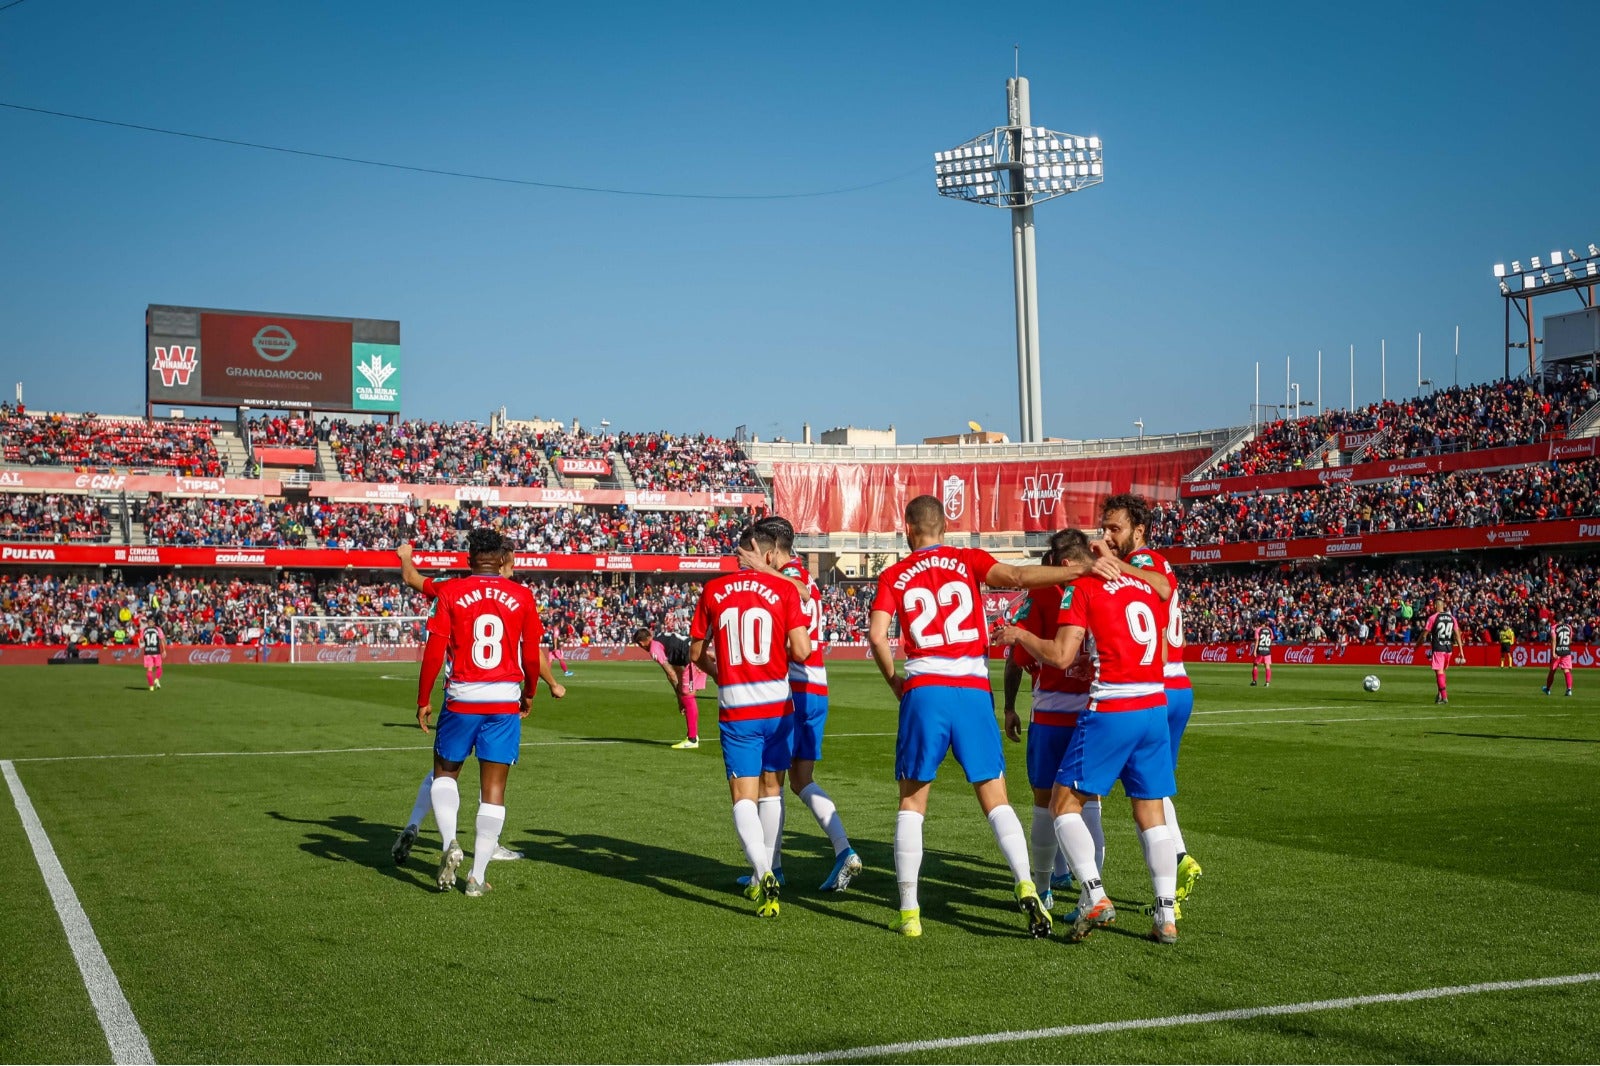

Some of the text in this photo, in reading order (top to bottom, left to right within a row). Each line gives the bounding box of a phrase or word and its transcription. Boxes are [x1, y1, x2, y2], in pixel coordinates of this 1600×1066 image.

[258, 339, 291, 347] NISSAN
[1561, 444, 1591, 454] CaixaBank
[563, 460, 604, 472] IDEAL
[183, 479, 219, 490] TIPSA
[541, 490, 584, 501] IDEAL
[2, 547, 56, 560] PULEVA
[128, 555, 160, 563] ALHAMBRA
[129, 548, 158, 556] CERVEZAS
[1190, 550, 1221, 560] PULEVA
[514, 558, 548, 567] ULEVA
[893, 555, 968, 590] DOMINGOS D.
[1103, 575, 1152, 595] SOLDADO
[713, 580, 779, 605] A.PUERTAS
[456, 588, 520, 612] YAN ETEKI
[903, 581, 979, 649] 22
[1166, 588, 1183, 648] 6
[719, 606, 773, 666] 10
[1125, 601, 1157, 665] 9
[1437, 622, 1454, 639] 24
[144, 632, 158, 647] 14
[471, 613, 504, 669] 8
[1259, 633, 1272, 647] 26
[1558, 631, 1570, 645] 15
